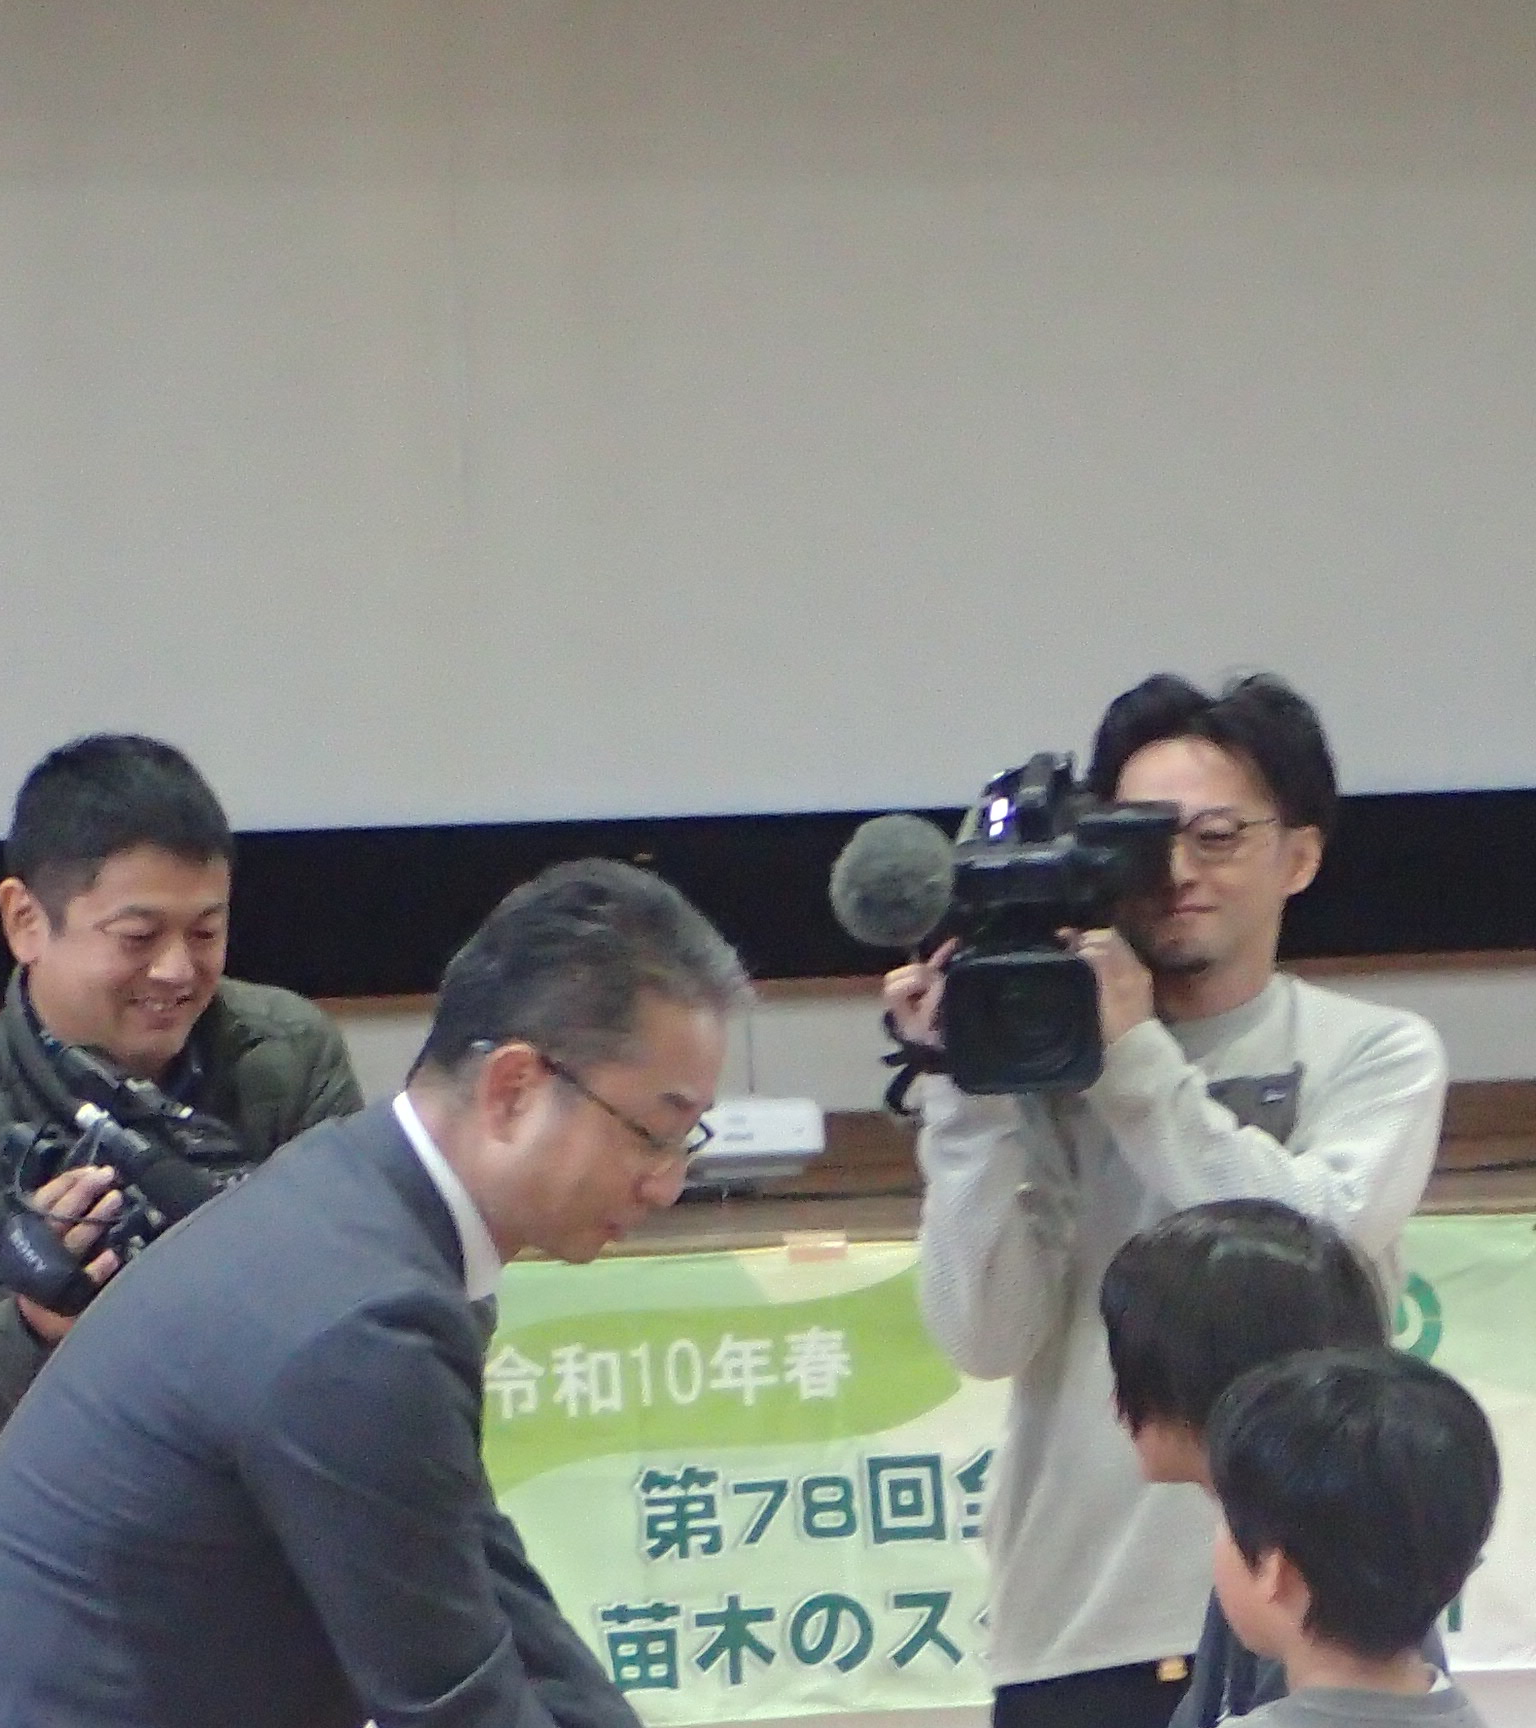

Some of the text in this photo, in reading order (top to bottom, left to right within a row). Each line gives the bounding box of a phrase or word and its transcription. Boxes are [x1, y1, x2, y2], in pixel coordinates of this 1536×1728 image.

[483, 1325, 853, 1420] 令和10年春
[600, 1590, 991, 1693] 苗木のス
